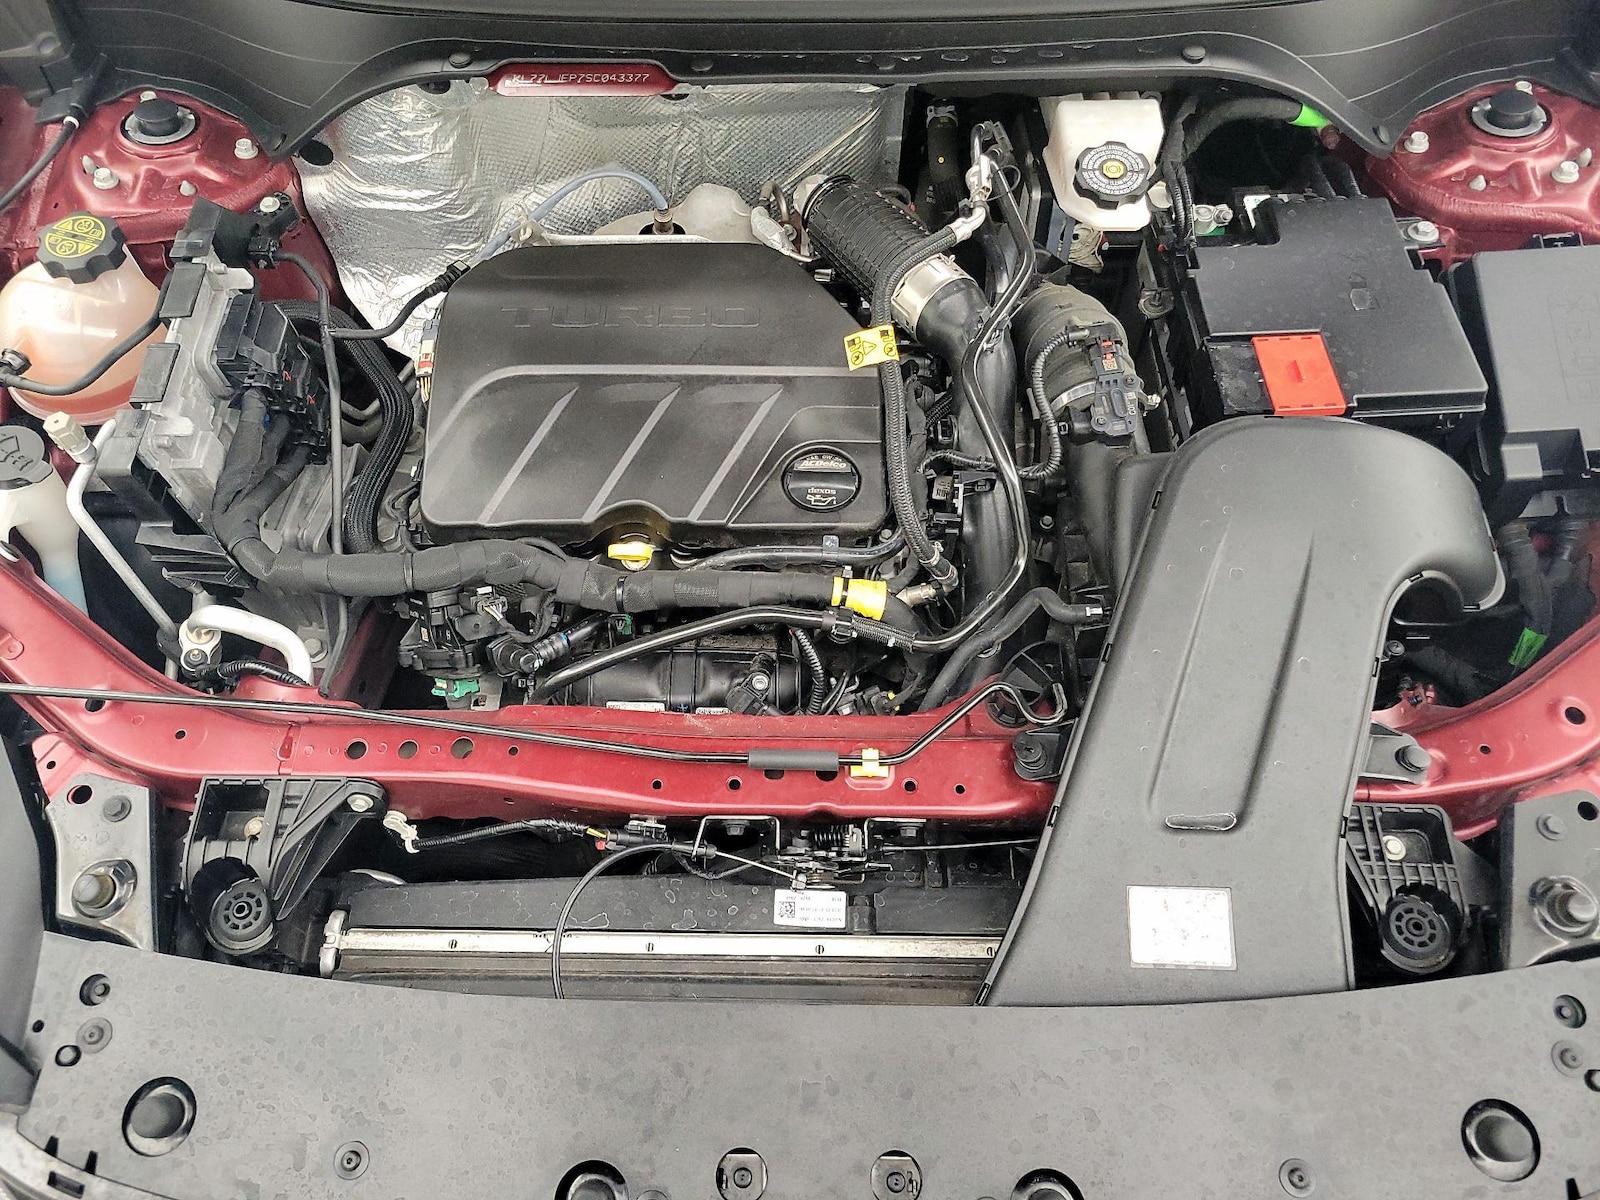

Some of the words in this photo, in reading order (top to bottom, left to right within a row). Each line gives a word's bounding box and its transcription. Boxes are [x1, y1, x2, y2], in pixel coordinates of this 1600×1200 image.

[501, 306, 760, 328] TURBO
[800, 460, 847, 468] ACDelco
[808, 487, 837, 495] dexos
